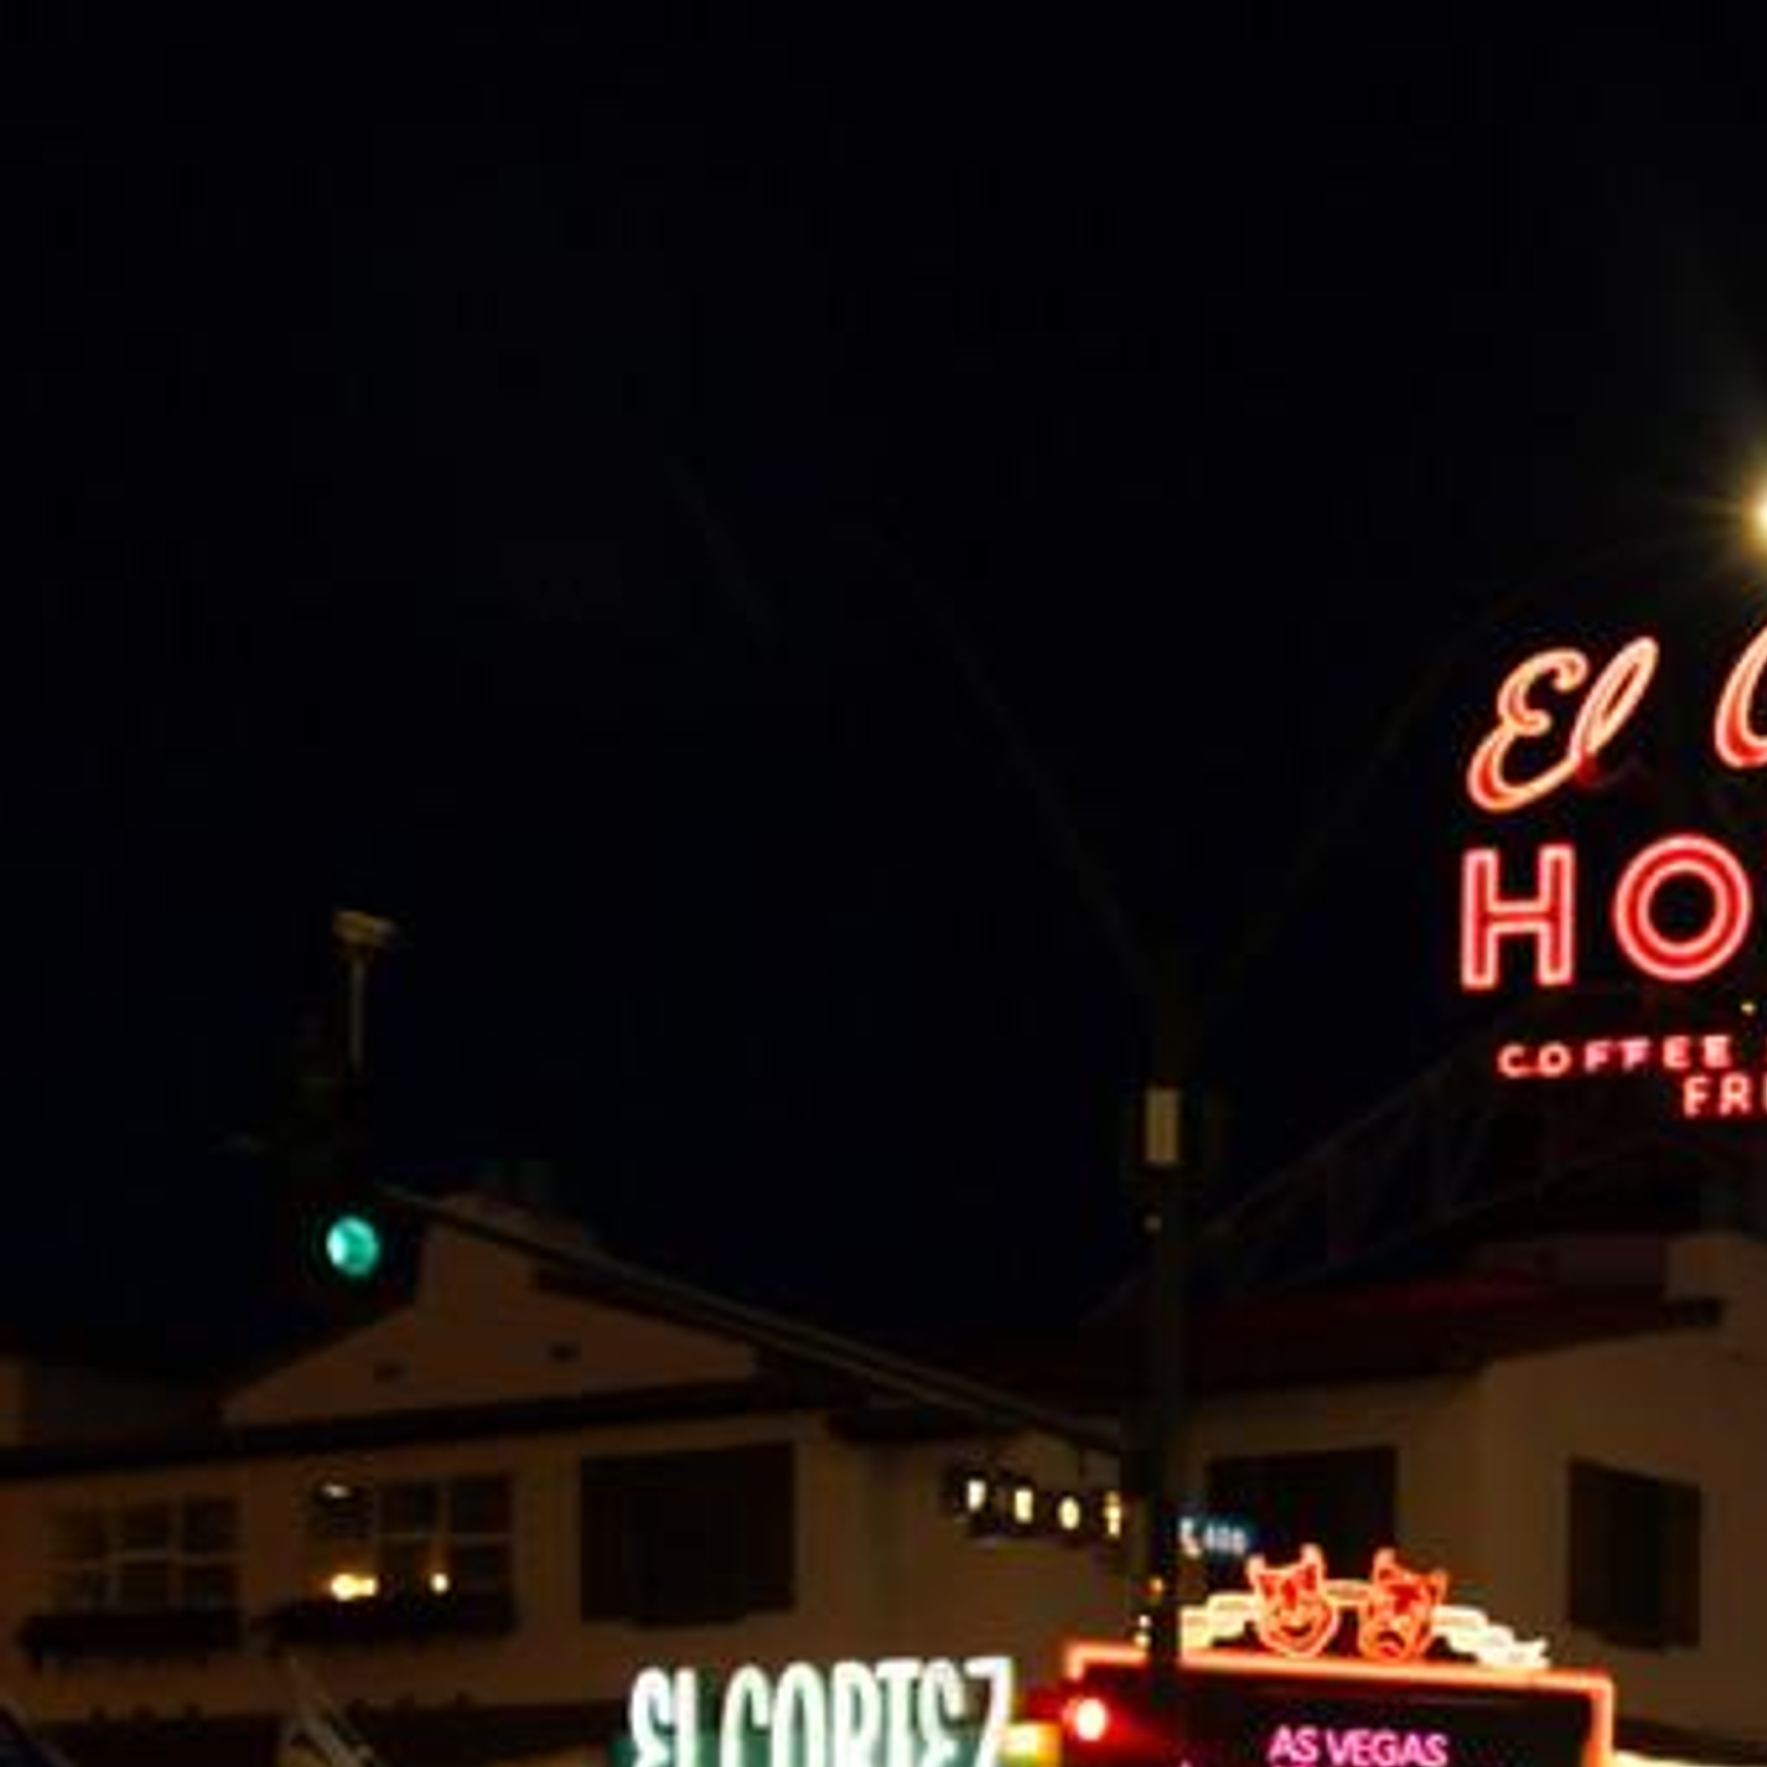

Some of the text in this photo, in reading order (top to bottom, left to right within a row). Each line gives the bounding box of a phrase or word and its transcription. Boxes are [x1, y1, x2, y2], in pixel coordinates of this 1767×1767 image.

[1467, 637, 1658, 811] El
[1497, 1033, 1733, 1079] COFFEE
[1268, 1725, 1321, 1764] AS
